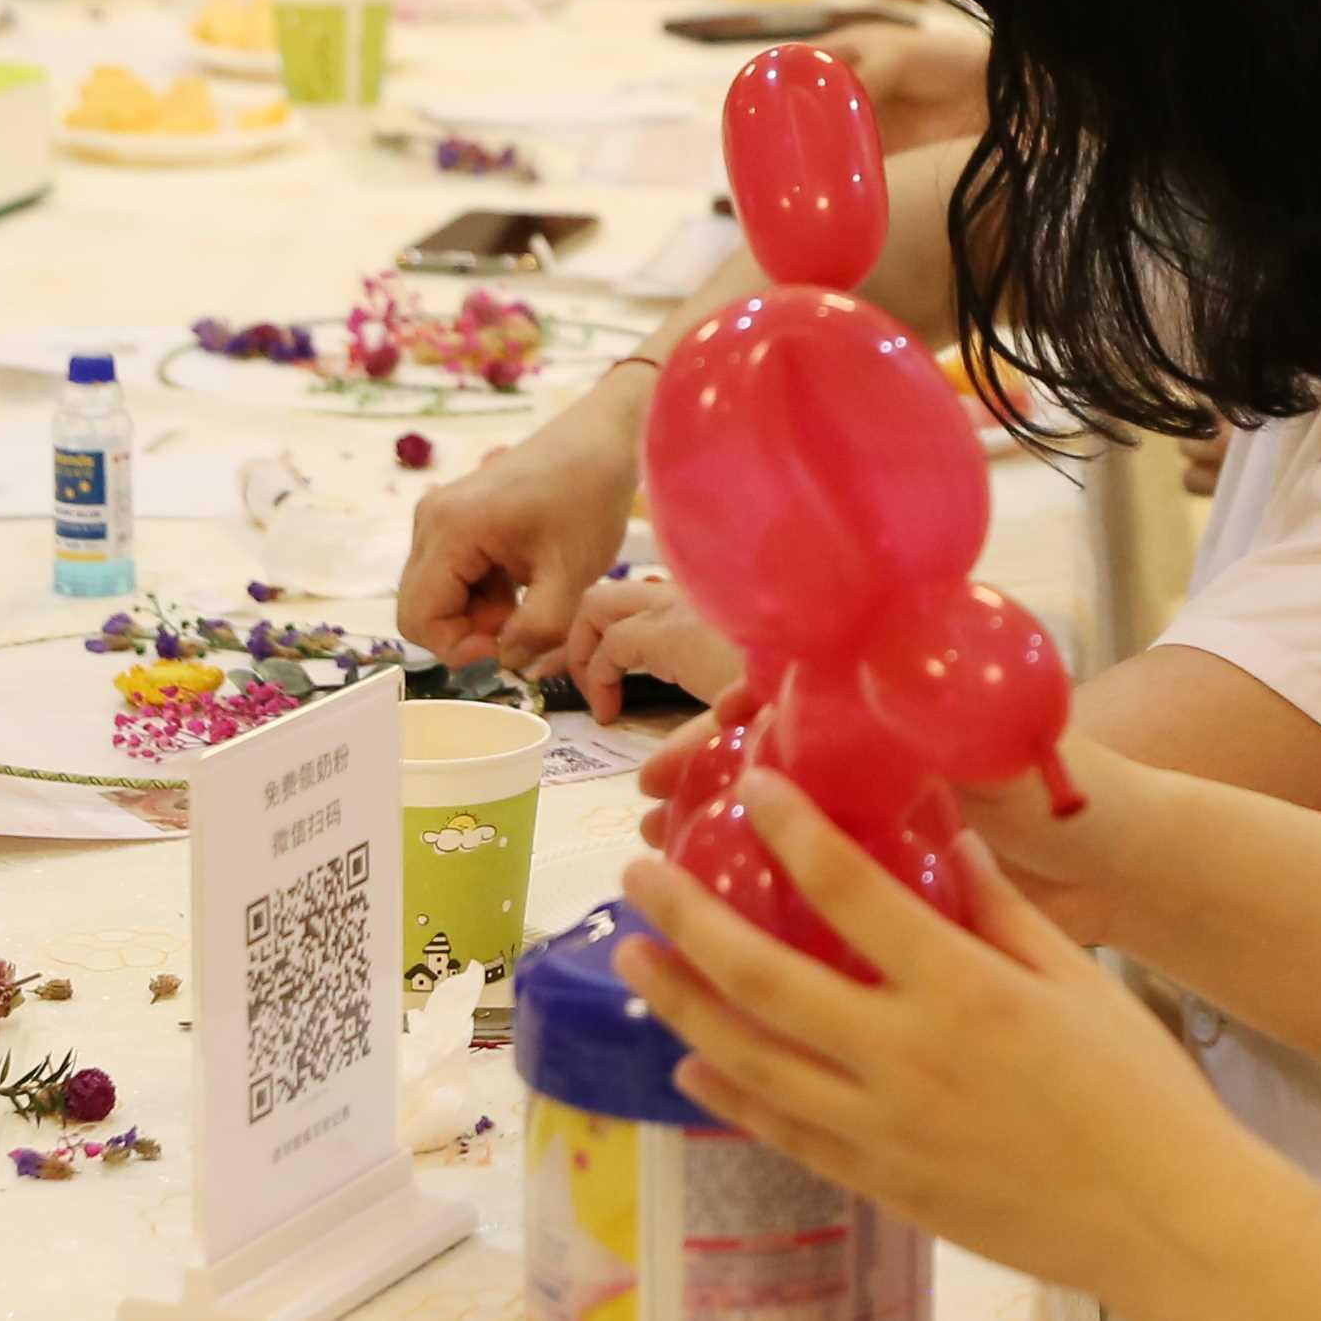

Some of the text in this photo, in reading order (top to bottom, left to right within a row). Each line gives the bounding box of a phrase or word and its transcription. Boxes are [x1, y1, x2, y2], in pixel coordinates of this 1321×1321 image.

[264, 742, 349, 811] 免费领奶粉
[272, 798, 342, 859] 微信扫码
